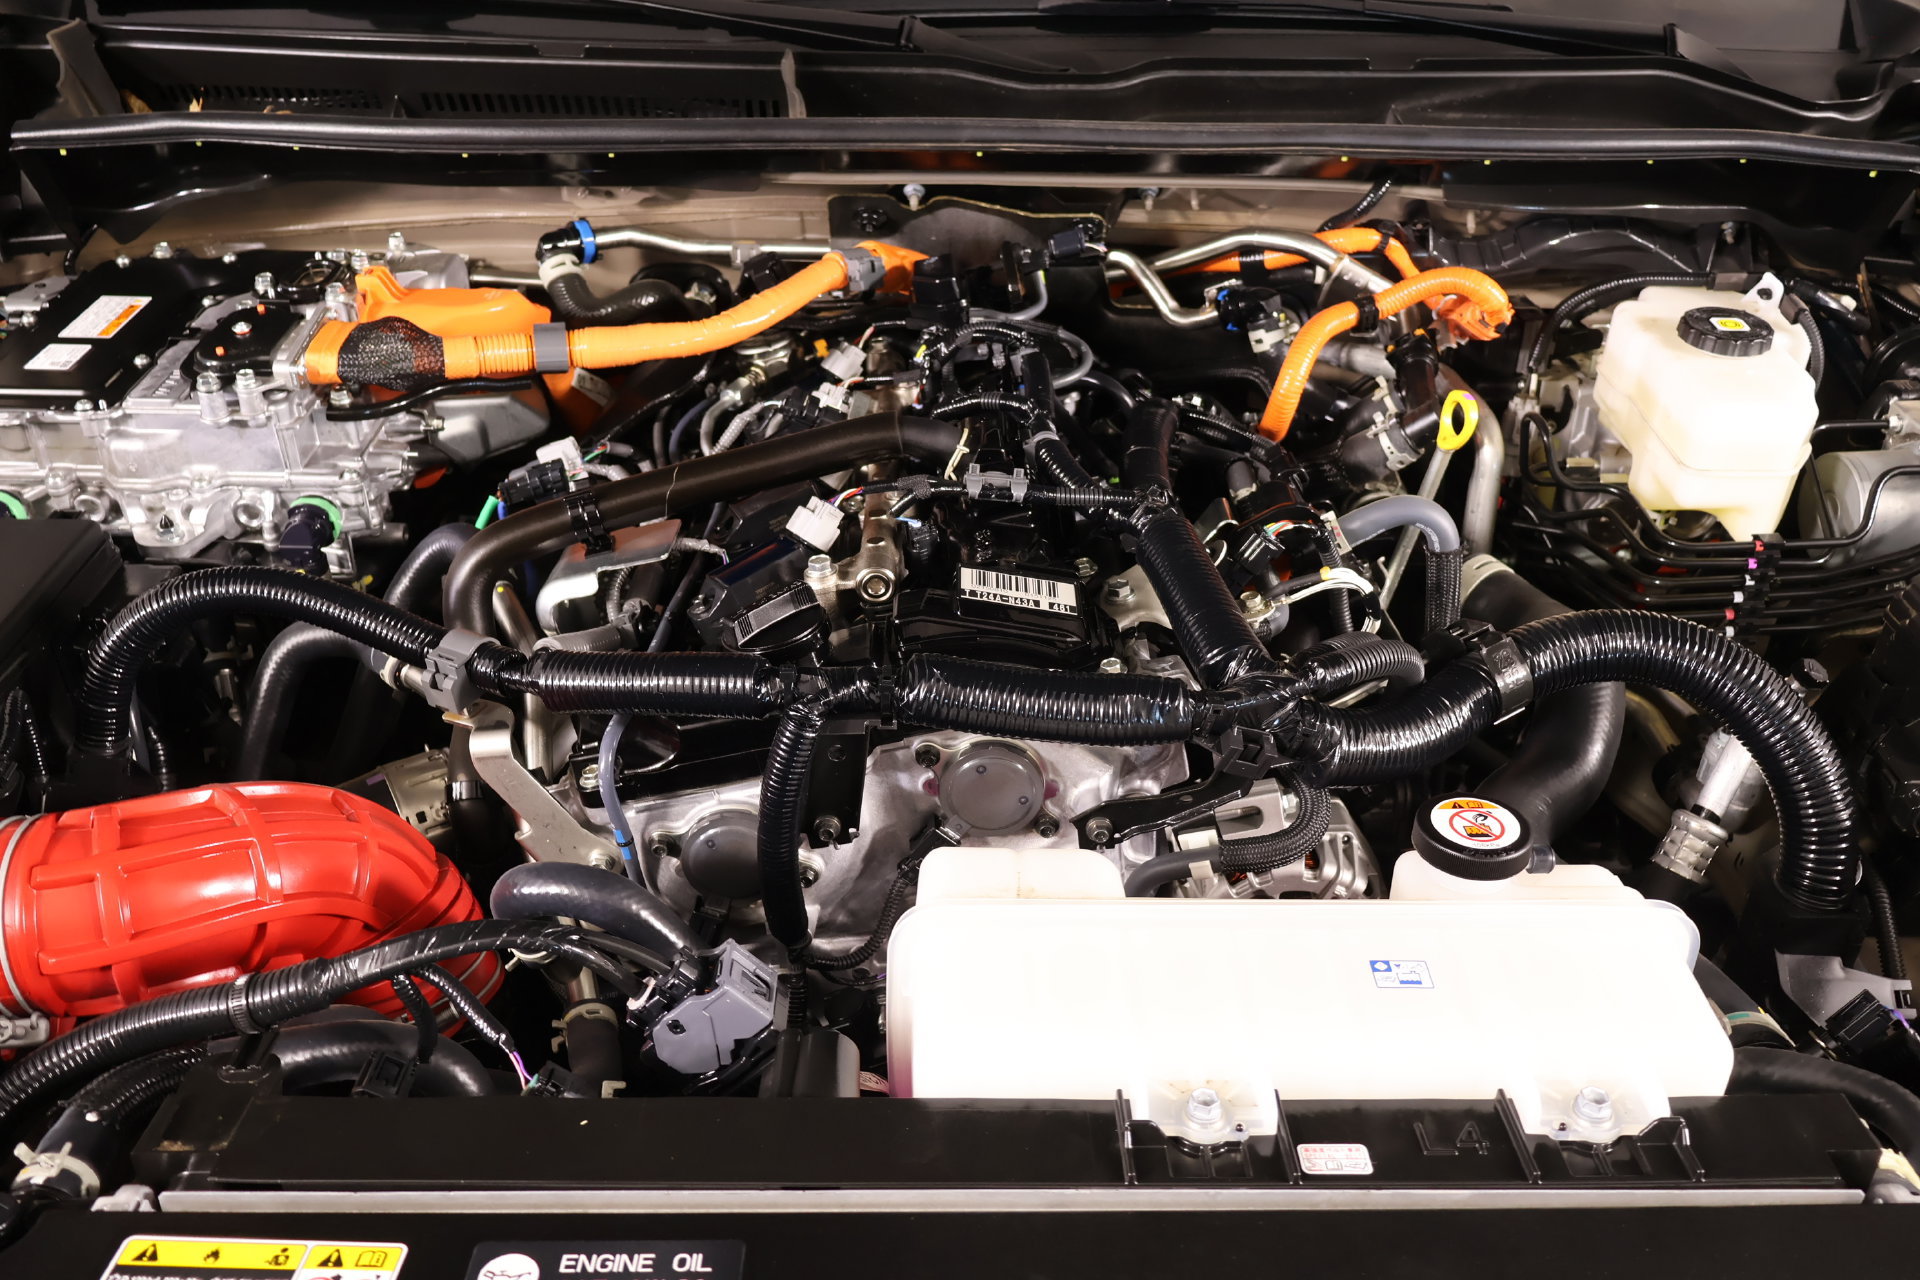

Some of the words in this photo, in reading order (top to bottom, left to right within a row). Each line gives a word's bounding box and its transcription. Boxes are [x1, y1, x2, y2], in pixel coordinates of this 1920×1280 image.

[964, 589, 971, 598] T
[976, 590, 1035, 608] T24A-N43A
[558, 1253, 656, 1274] ENGINE
[671, 1252, 713, 1273] OIL
